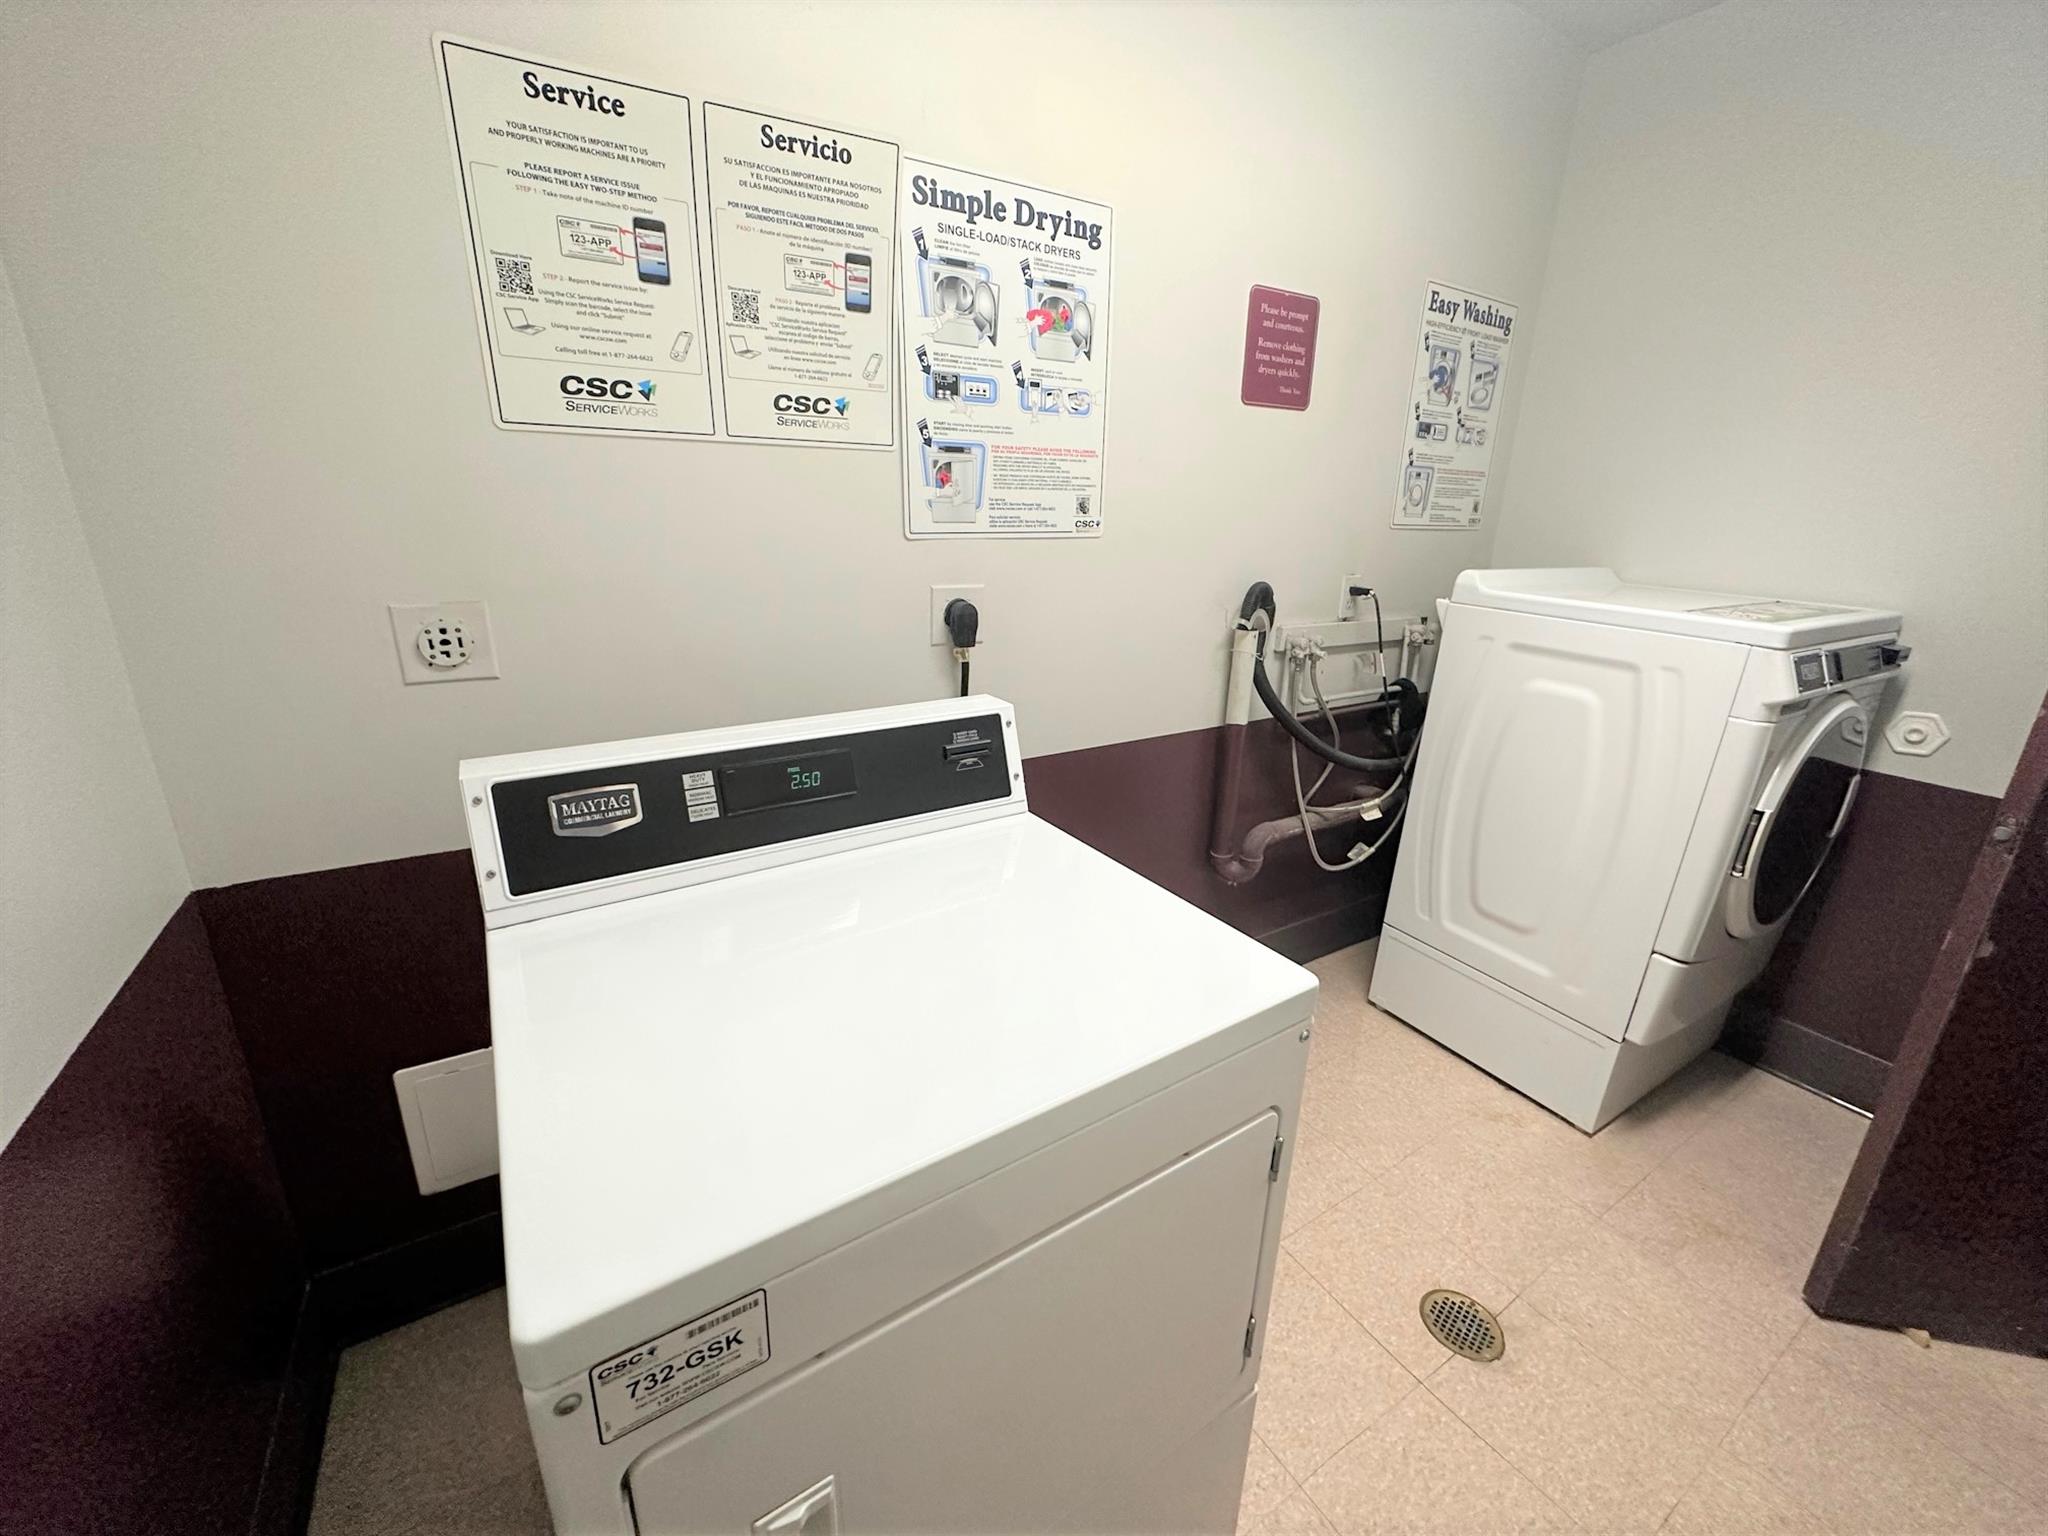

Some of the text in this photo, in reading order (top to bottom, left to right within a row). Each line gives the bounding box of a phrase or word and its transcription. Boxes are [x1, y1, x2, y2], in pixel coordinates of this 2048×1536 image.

[522, 71, 626, 117] Service
[486, 126, 665, 169] AND PROPERLY WORKING MACHINES ARE A PRIORITY
[505, 120, 648, 156] YOUR SATISFACTION IS IMPORTANT TO US
[760, 124, 852, 165] Servicio
[506, 168, 658, 203] FOLLOWING THE EASY TWO-STEP METHOD
[523, 161, 640, 190] PLEASE REPORT A SERVICE ISSUE
[723, 157, 881, 194] SU SATISFACCION ES IMPORTANTE PARA NOSOTROS
[755, 173, 763, 181] EL
[764, 174, 822, 191] FUNCIONAMIENTO
[823, 185, 859, 198] APROPIADO
[514, 183, 653, 214] STEP 1 Take note of the machine ID number
[738, 179, 869, 209] DE LAS MAQUINAS ES NUESTRA PRIORIDAD
[727, 200, 739, 209] POR
[761, 206, 785, 217] REPORTE
[786, 210, 815, 222] CUALQUIER
[816, 216, 844, 227] PROBLEMA
[845, 221, 854, 229] DEL
[744, 212, 775, 223] SIGUIENDO
[776, 217, 788, 226] ESTE
[804, 222, 827, 232] METODO
[836, 227, 847, 235] DOS
[847, 229, 864, 238] PASOS
[912, 175, 1103, 250] Simple Drying
[569, 233, 612, 248] 123-APP
[937, 222, 1042, 252] SINGLE-LOAD/STACK
[1043, 244, 1081, 261] DRYERS
[542, 272, 558, 280] STEP
[568, 276, 589, 286] Report
[601, 280, 622, 289] service
[792, 268, 826, 281] 123-APP
[1260, 302, 1309, 323] Please be prompt
[1262, 317, 1274, 328] and
[1428, 290, 1513, 337] Easy Washing
[550, 322, 569, 330] Using
[554, 346, 576, 354] Calling
[1255, 349, 1305, 365] from washers and
[1257, 336, 1306, 355] Remove clothing
[1258, 363, 1276, 376] dryers
[558, 374, 634, 399] CSC
[772, 393, 831, 415] CSC
[1075, 520, 1095, 528] CSC
[791, 771, 820, 790] 2.50
[561, 794, 630, 817] MAYTAG
[597, 1352, 644, 1381] CSC
[625, 1329, 744, 1398] 732-GSK
